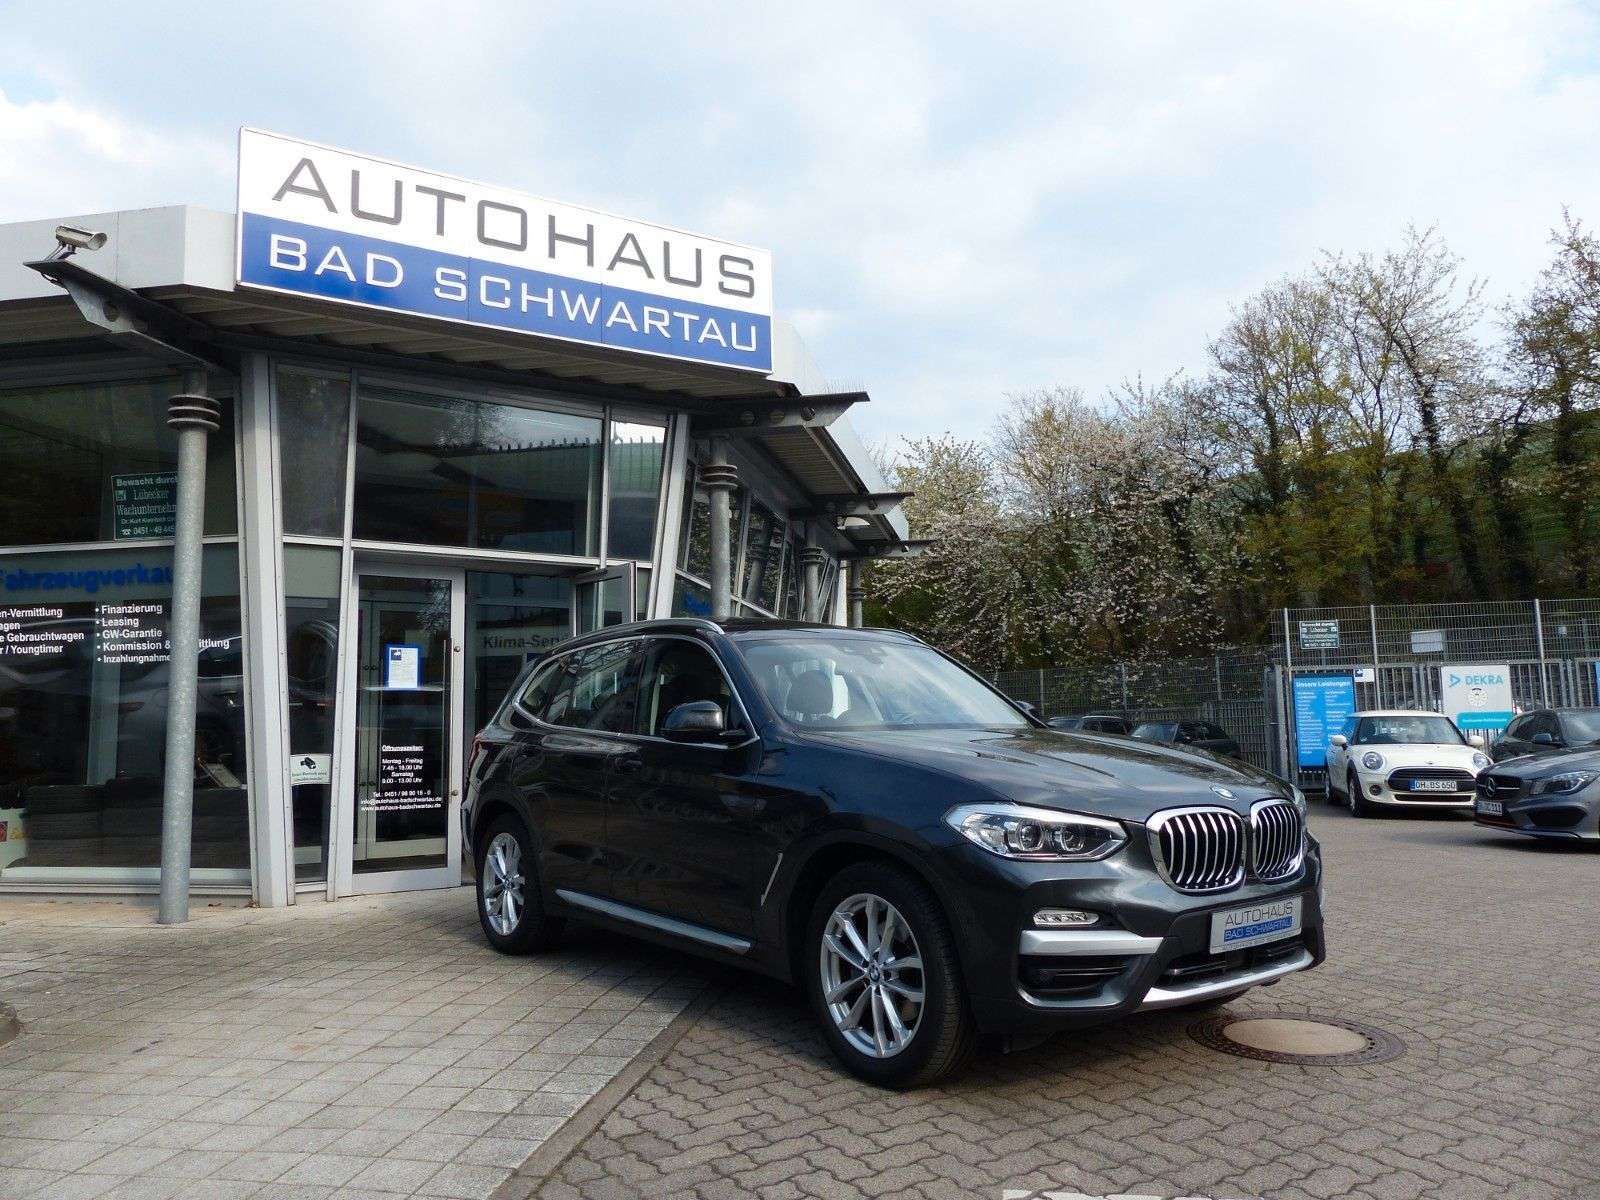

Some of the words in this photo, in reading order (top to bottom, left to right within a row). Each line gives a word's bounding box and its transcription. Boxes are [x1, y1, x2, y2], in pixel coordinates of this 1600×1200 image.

[272, 157, 756, 299] AUTOHAUS
[269, 233, 404, 289] BAD
[433, 266, 758, 352] SCHWARTAU
[101, 603, 163, 615] Finanzierung
[102, 617, 140, 628] Leasing
[7, 632, 85, 642] Gebrauchtwagen
[102, 628, 163, 639] GW-Garantie
[103, 641, 162, 651] Kommission
[198, 638, 230, 649] ittlung
[483, 634, 562, 649] Klima-Serv
[11, 644, 64, 655] Youngtimer
[1465, 675, 1504, 685] DEKRA
[1225, 901, 1293, 927] AUTOHAUS
[1225, 928, 1245, 940] BAD
